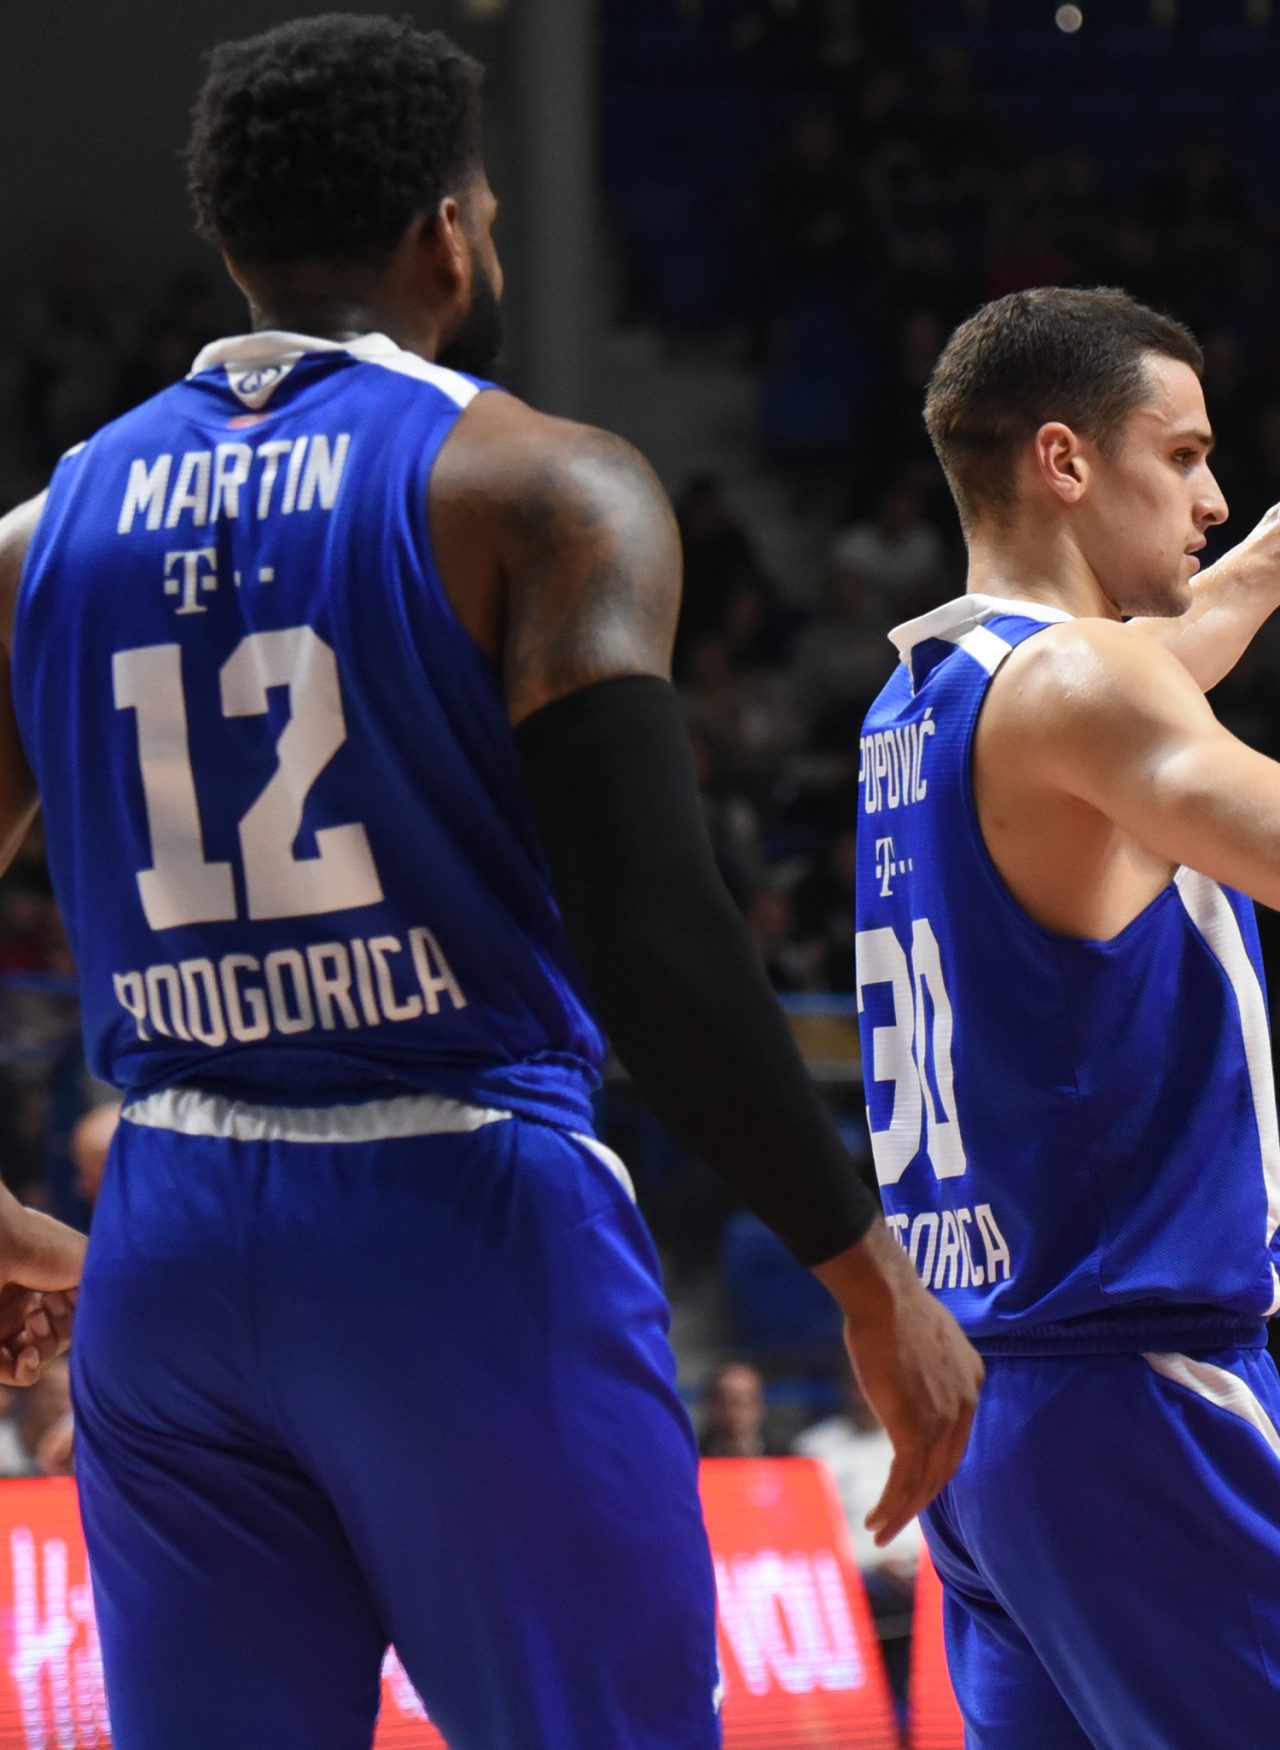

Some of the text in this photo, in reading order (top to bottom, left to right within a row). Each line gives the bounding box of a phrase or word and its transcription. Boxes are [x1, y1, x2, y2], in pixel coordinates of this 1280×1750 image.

[117, 433, 350, 535] MARTIN
[112, 625, 384, 931] 12
[112, 927, 468, 1047] PODGORICA
[855, 918, 967, 1184] 30
